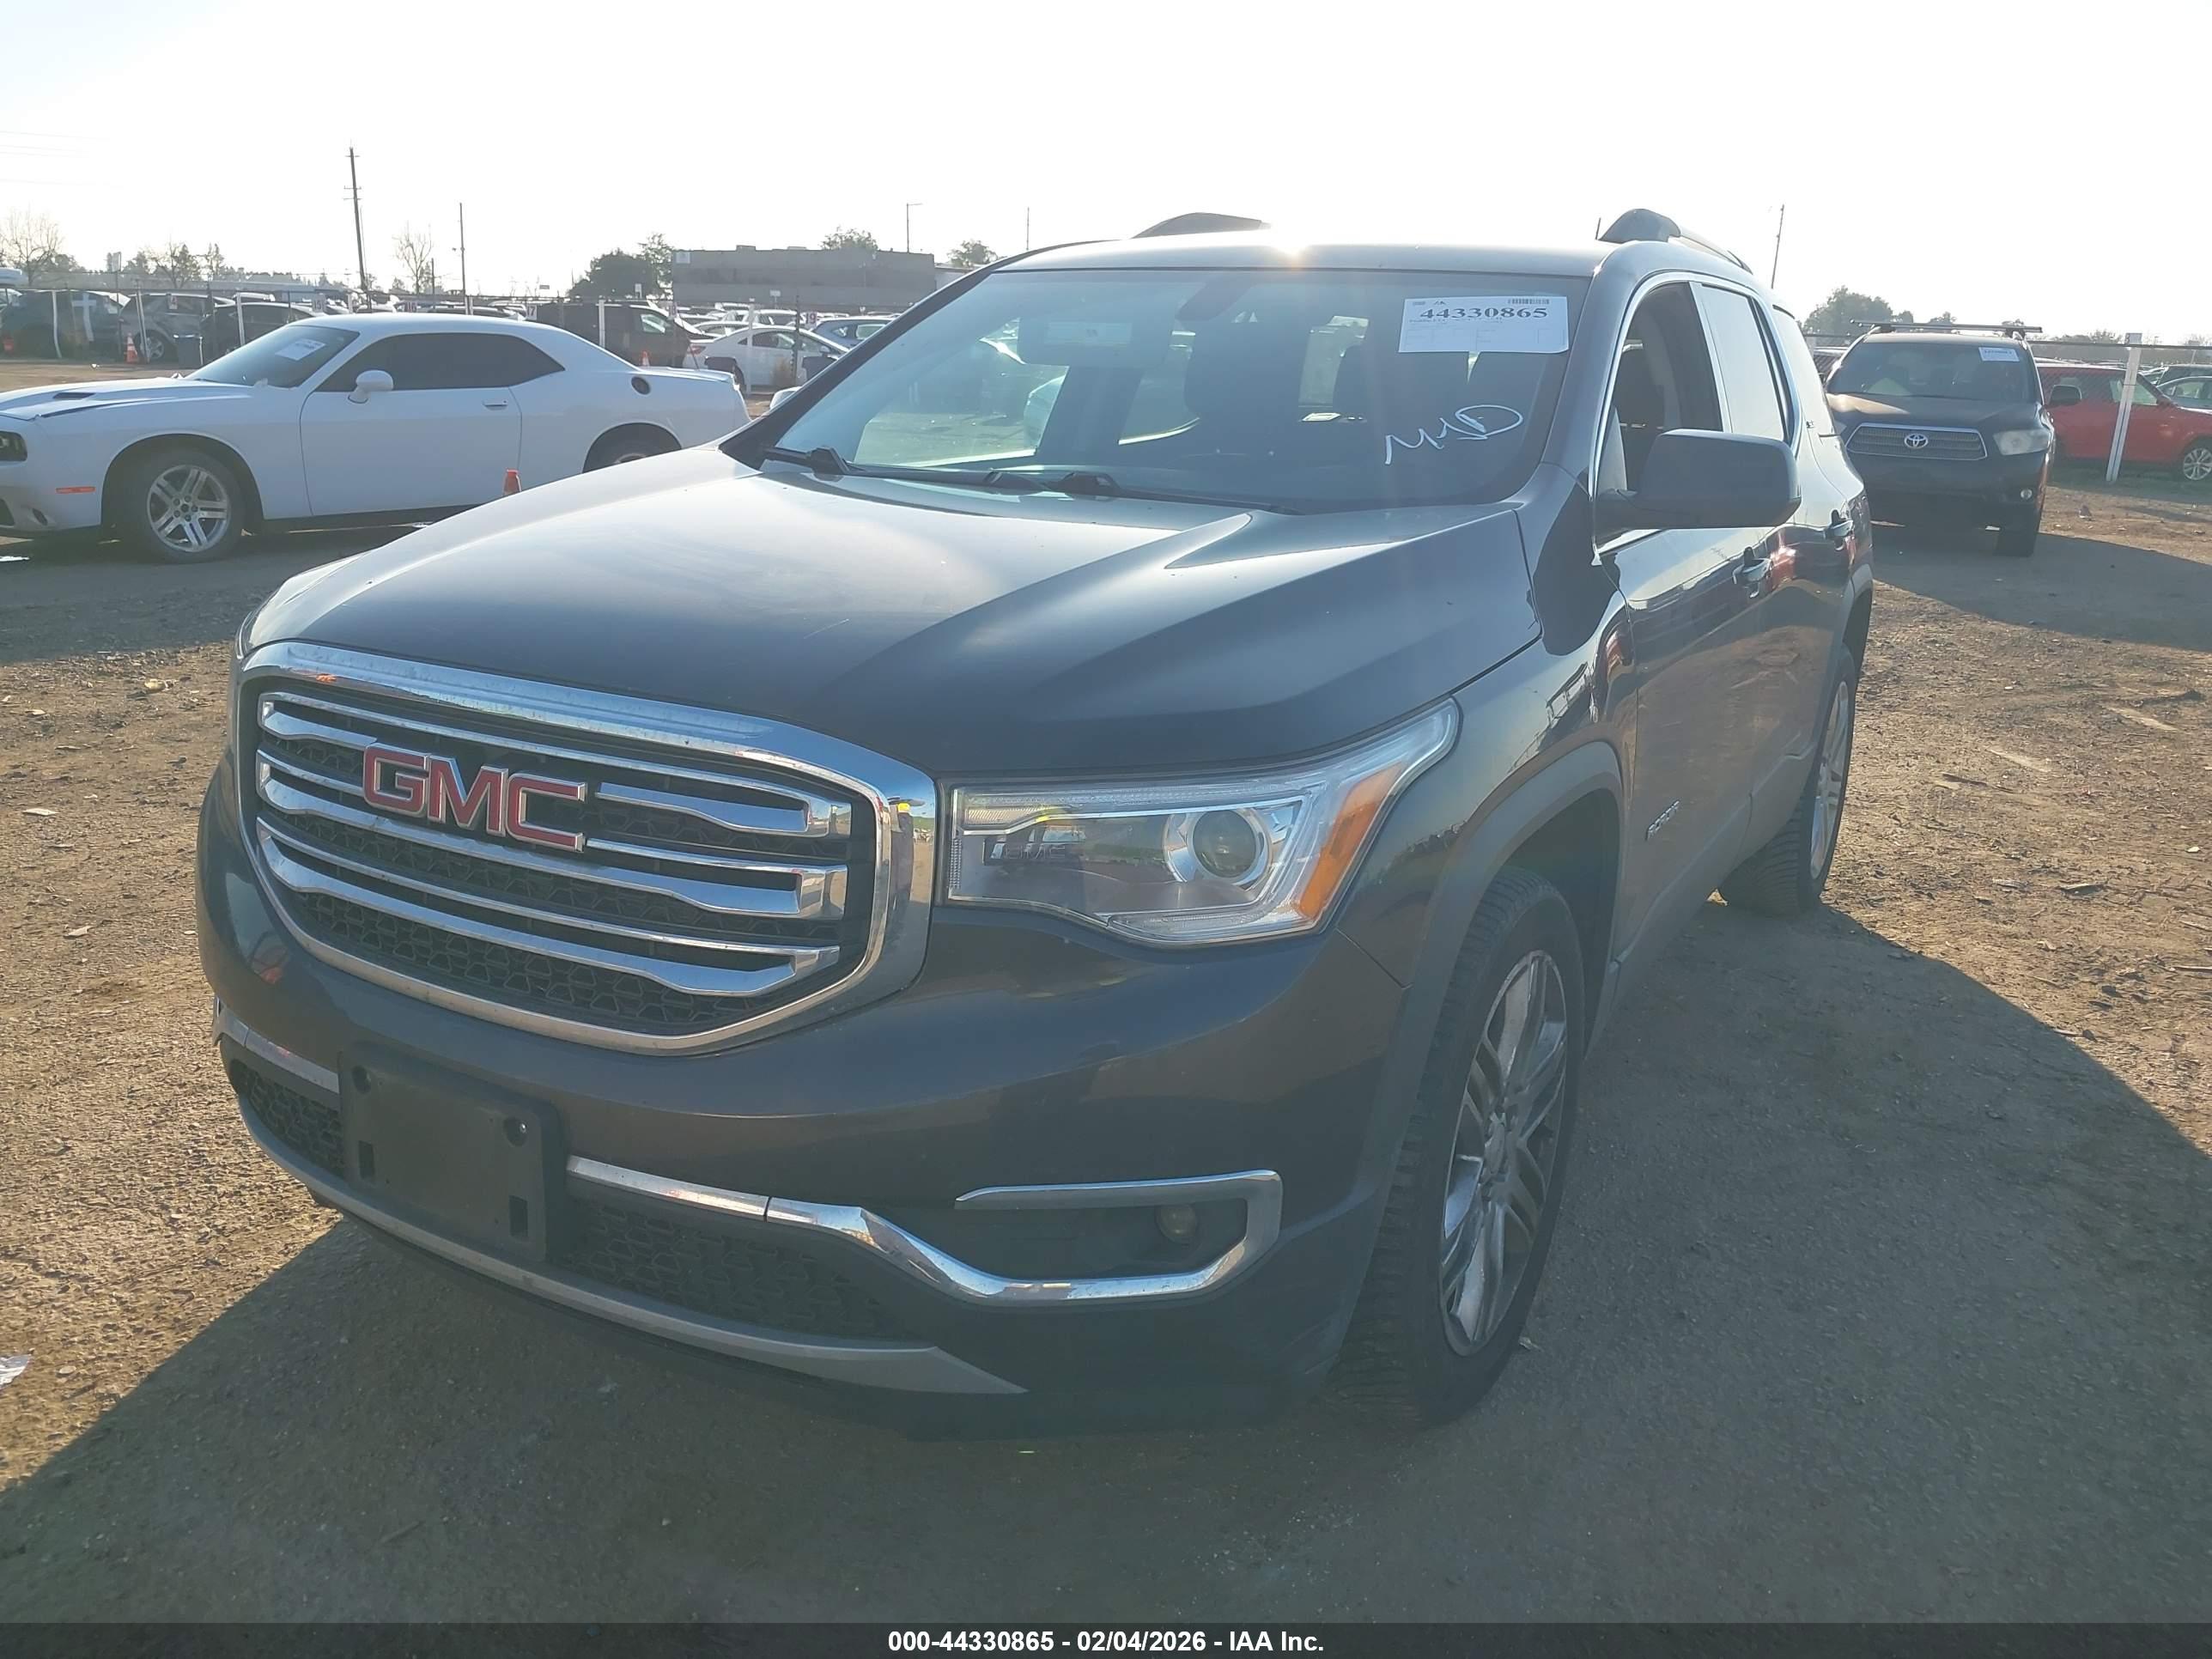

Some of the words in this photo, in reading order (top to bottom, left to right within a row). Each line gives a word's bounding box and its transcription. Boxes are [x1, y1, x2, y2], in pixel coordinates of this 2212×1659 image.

[805, 313, 817, 324] 19
[1419, 307, 1548, 319] 44330865
[362, 742, 587, 853] GMC
